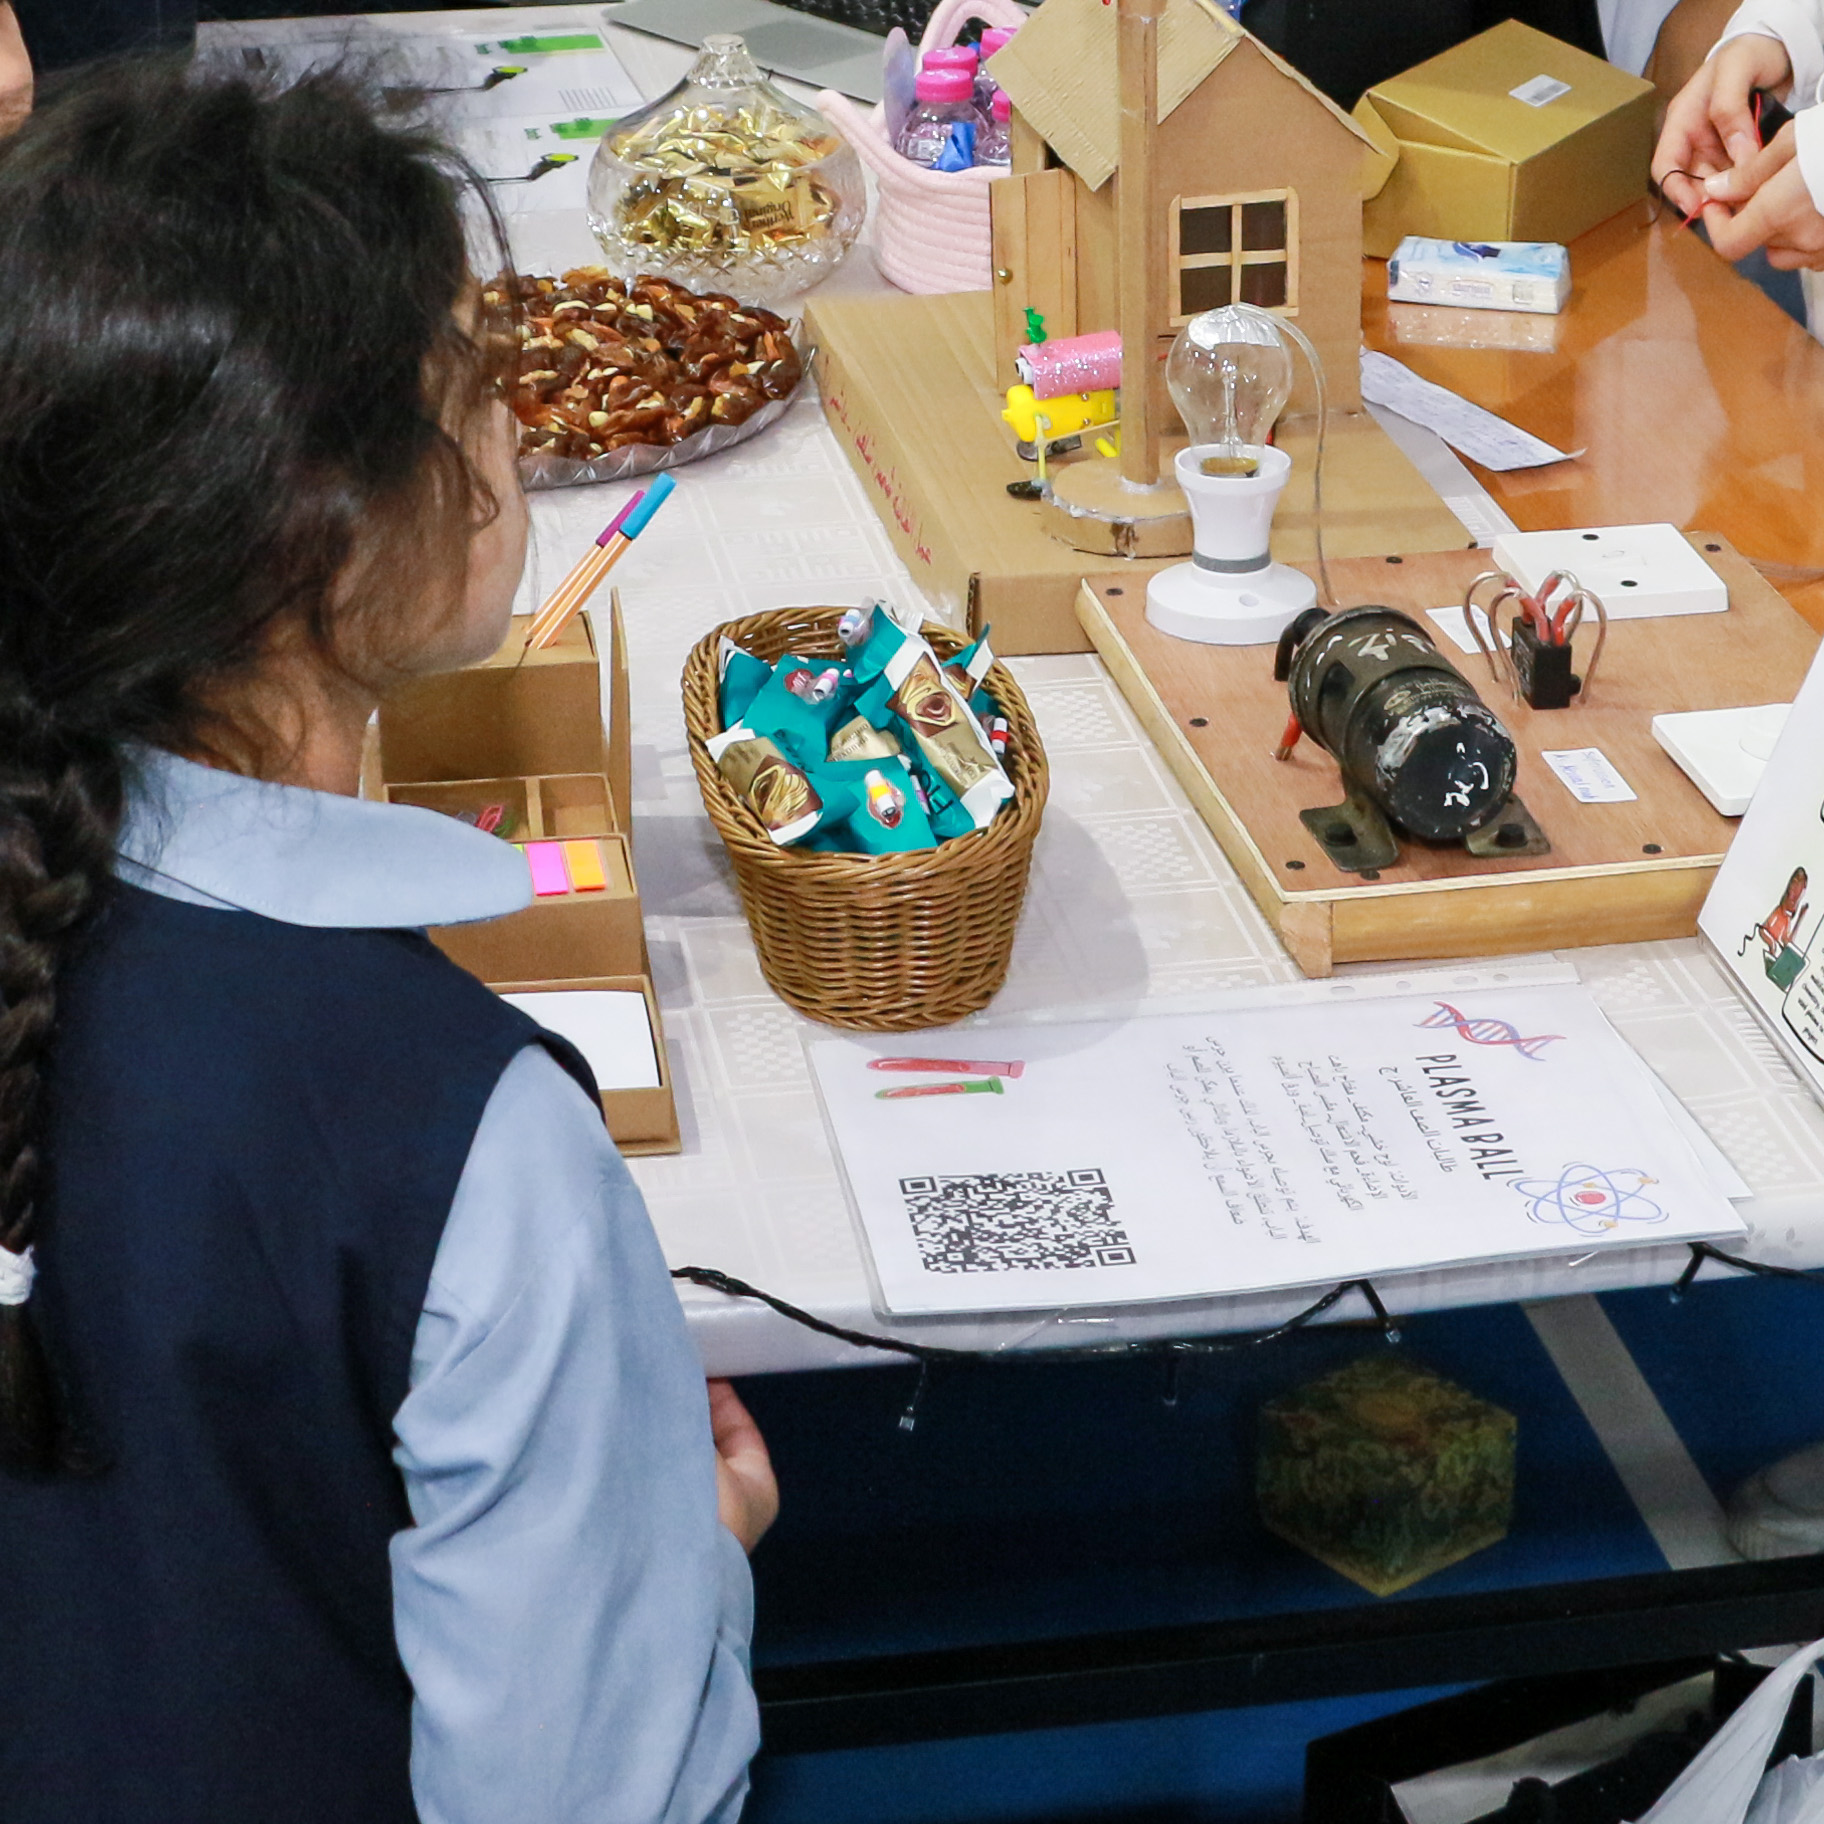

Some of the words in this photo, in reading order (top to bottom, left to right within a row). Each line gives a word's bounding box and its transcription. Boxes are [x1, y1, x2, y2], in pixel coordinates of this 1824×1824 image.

[1410, 1109, 1439, 1137] الصف
[1417, 1055, 1493, 1128] PLASMA
[1461, 1133, 1523, 1179] BALL
[1427, 1139, 1457, 1172] طالبات
